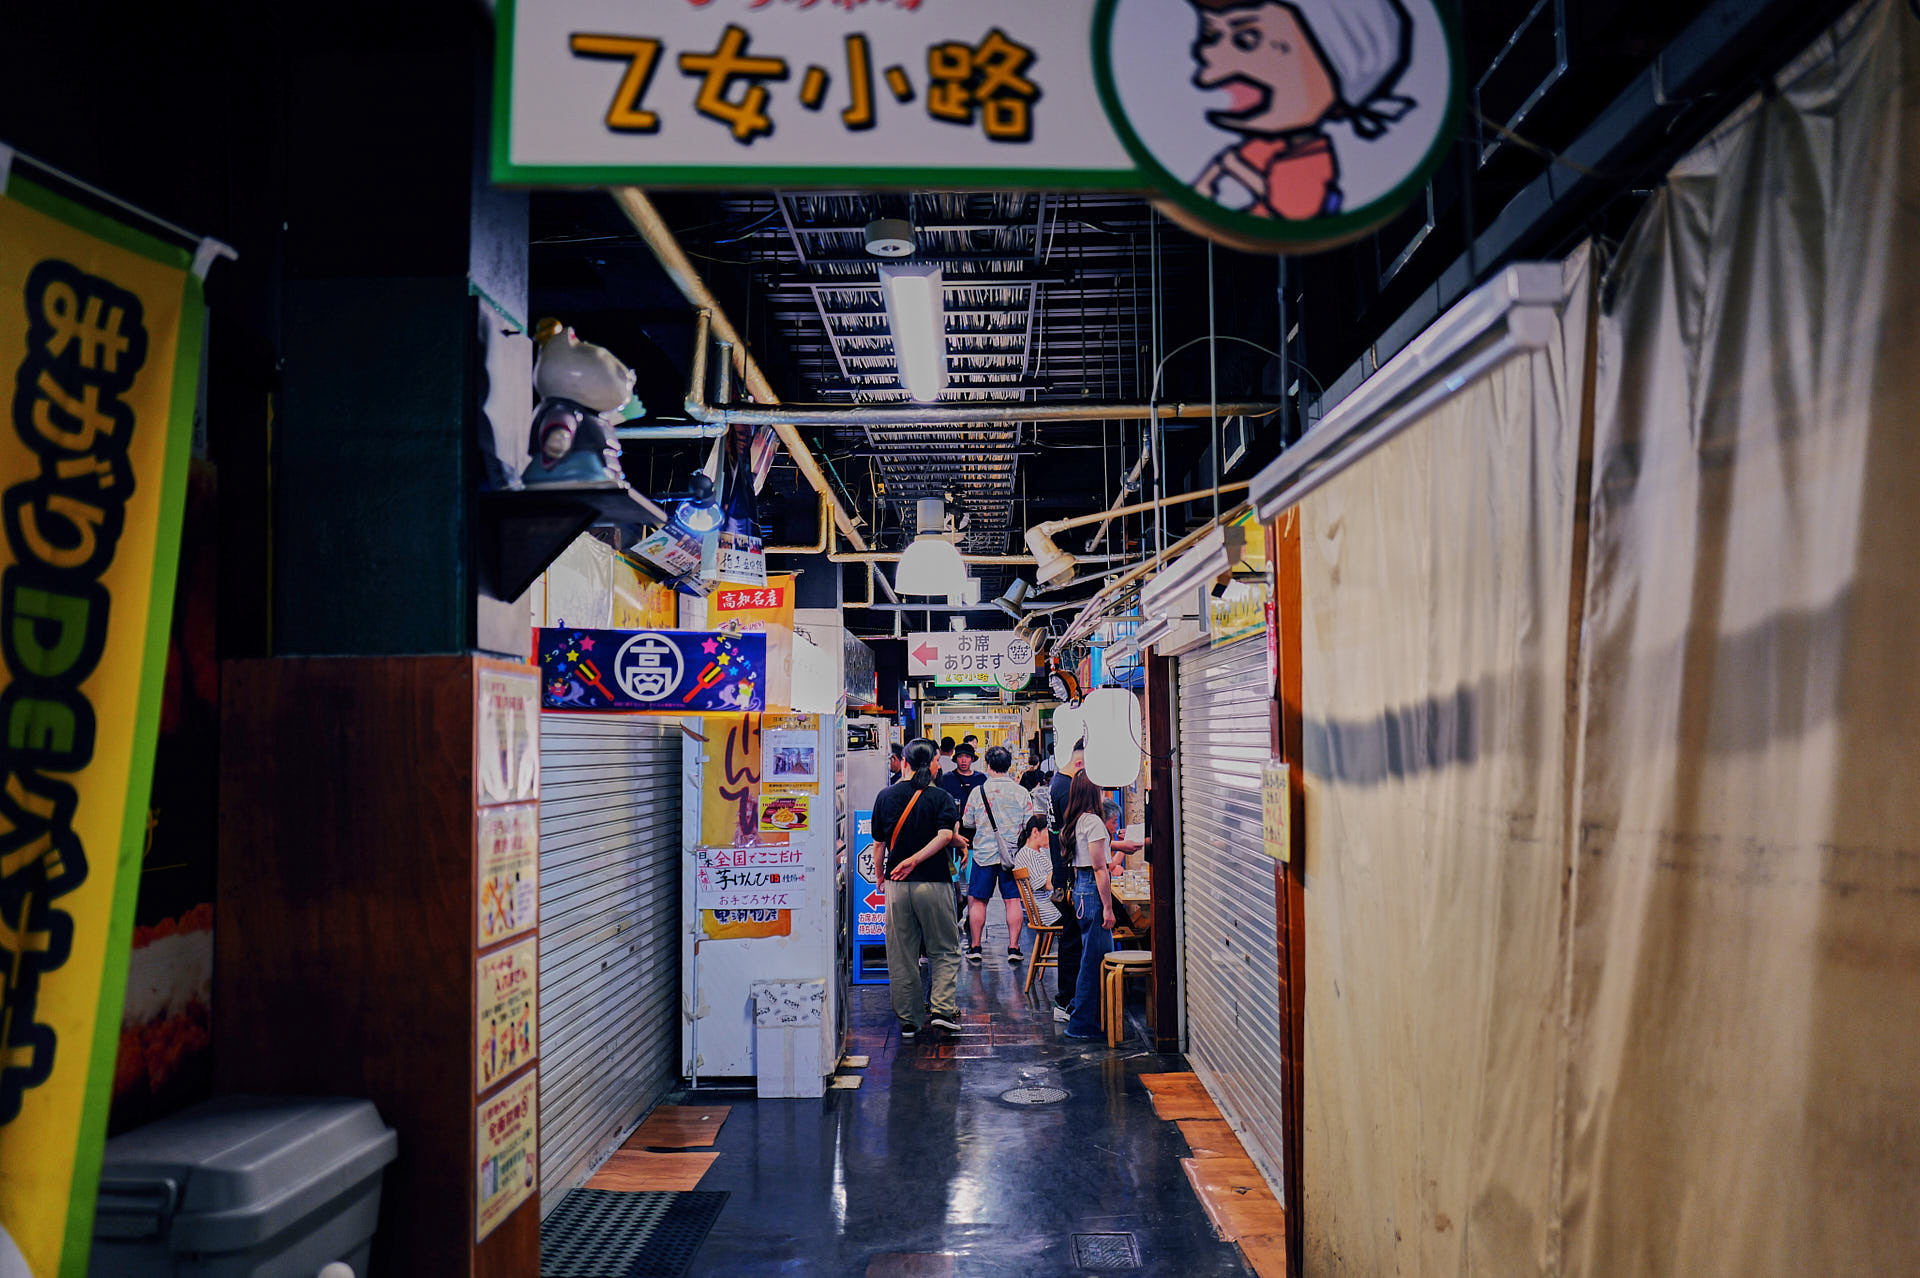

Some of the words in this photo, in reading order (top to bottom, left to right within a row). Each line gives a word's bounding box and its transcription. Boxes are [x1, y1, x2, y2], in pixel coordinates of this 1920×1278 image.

[569, 24, 1043, 145] 乙女小路
[722, 590, 777, 608] 高知名産
[958, 635, 989, 652] お席
[944, 653, 1004, 670] あります
[714, 849, 803, 868] 全国でここだけ
[715, 869, 769, 890] 芋けんぴ
[719, 894, 789, 905] お手ごろサイズ
[857, 924, 886, 935] 持ち込み
